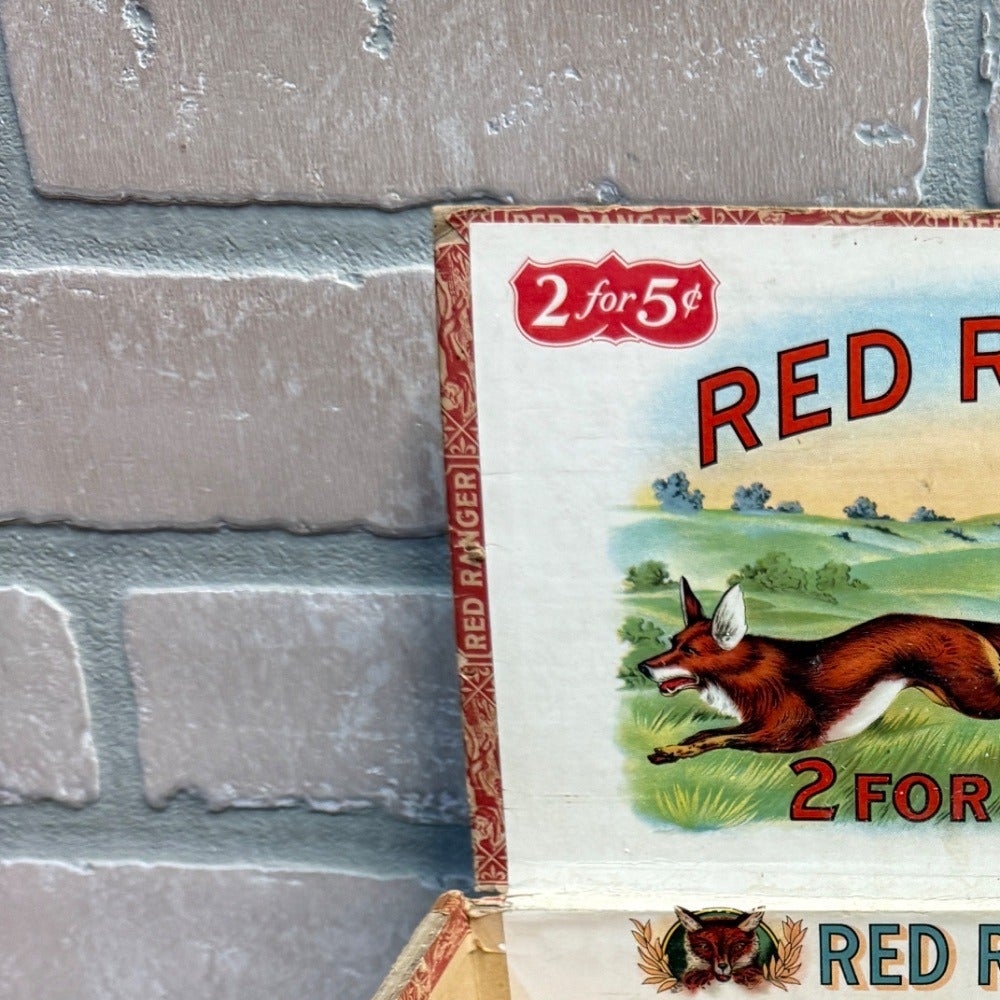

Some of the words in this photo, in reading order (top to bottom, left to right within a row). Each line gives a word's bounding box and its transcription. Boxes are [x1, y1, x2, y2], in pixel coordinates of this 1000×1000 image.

[531, 273, 570, 326] 2
[575, 279, 637, 320] for
[697, 328, 913, 469] RED
[462, 597, 488, 651] RED
[789, 759, 836, 824] 2
[855, 773, 993, 824] FOR
[819, 923, 952, 991] RED
